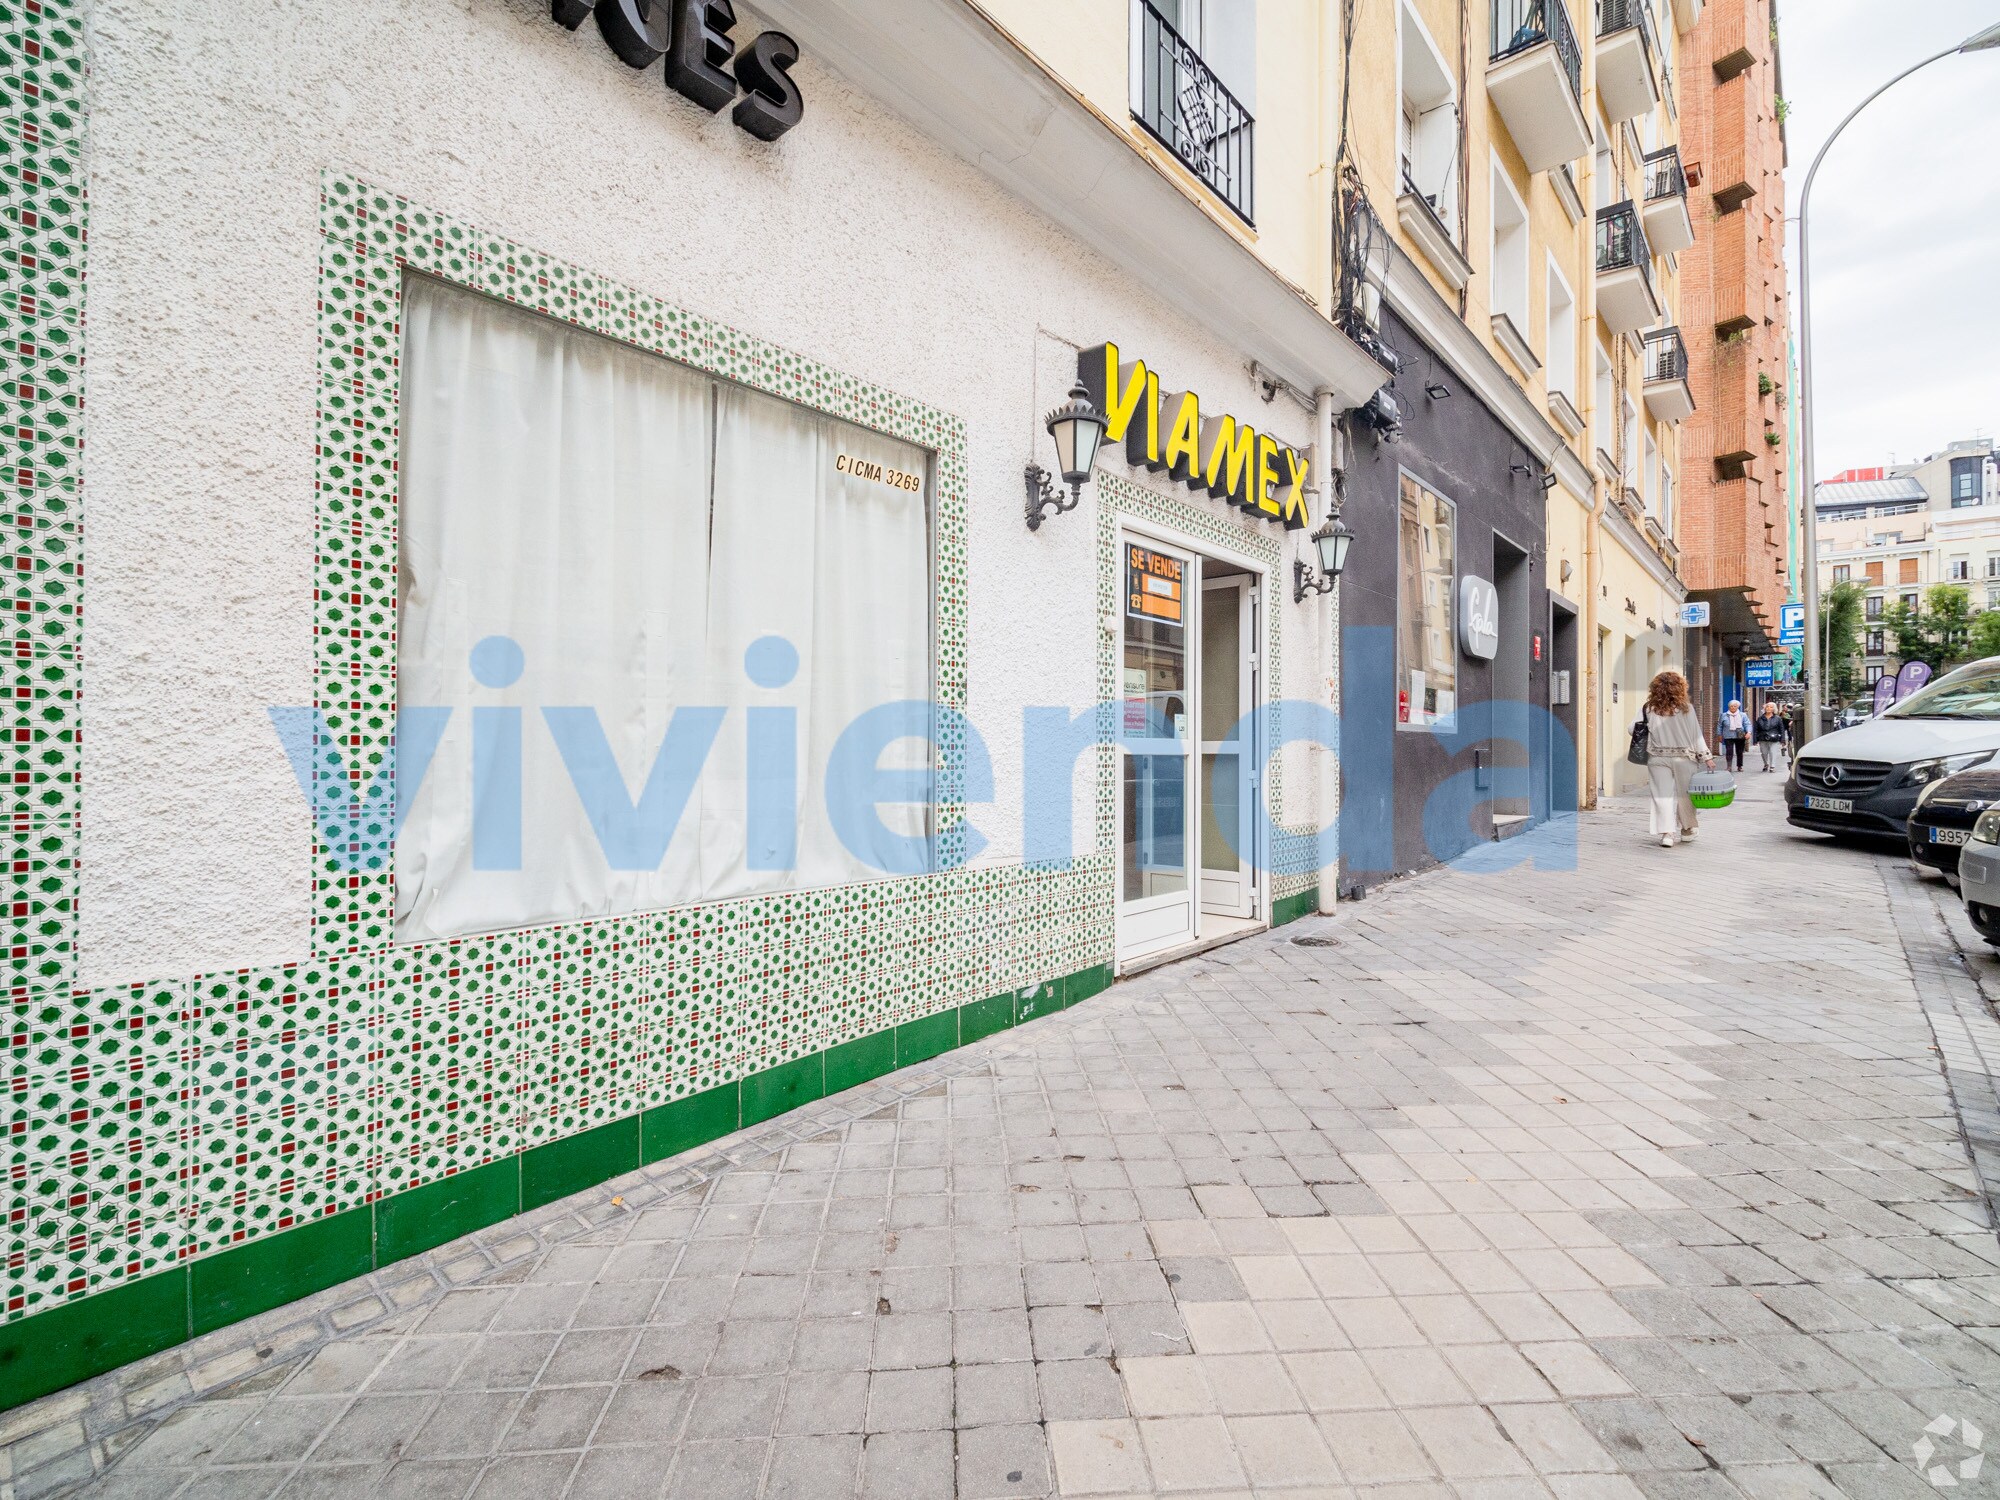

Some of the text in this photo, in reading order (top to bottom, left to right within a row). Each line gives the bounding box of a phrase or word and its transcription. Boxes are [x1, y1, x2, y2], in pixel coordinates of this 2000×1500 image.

[1104, 340, 1310, 529] VIAMEX
[836, 454, 920, 492] CICMA 3269
[1131, 548, 1182, 580] SE VENDE
[1785, 607, 1805, 628] P
[1910, 666, 1923, 679] P
[1883, 680, 1893, 690] P
[1810, 797, 1851, 812] 7325 LDM
[1938, 829, 1972, 844] 9957
